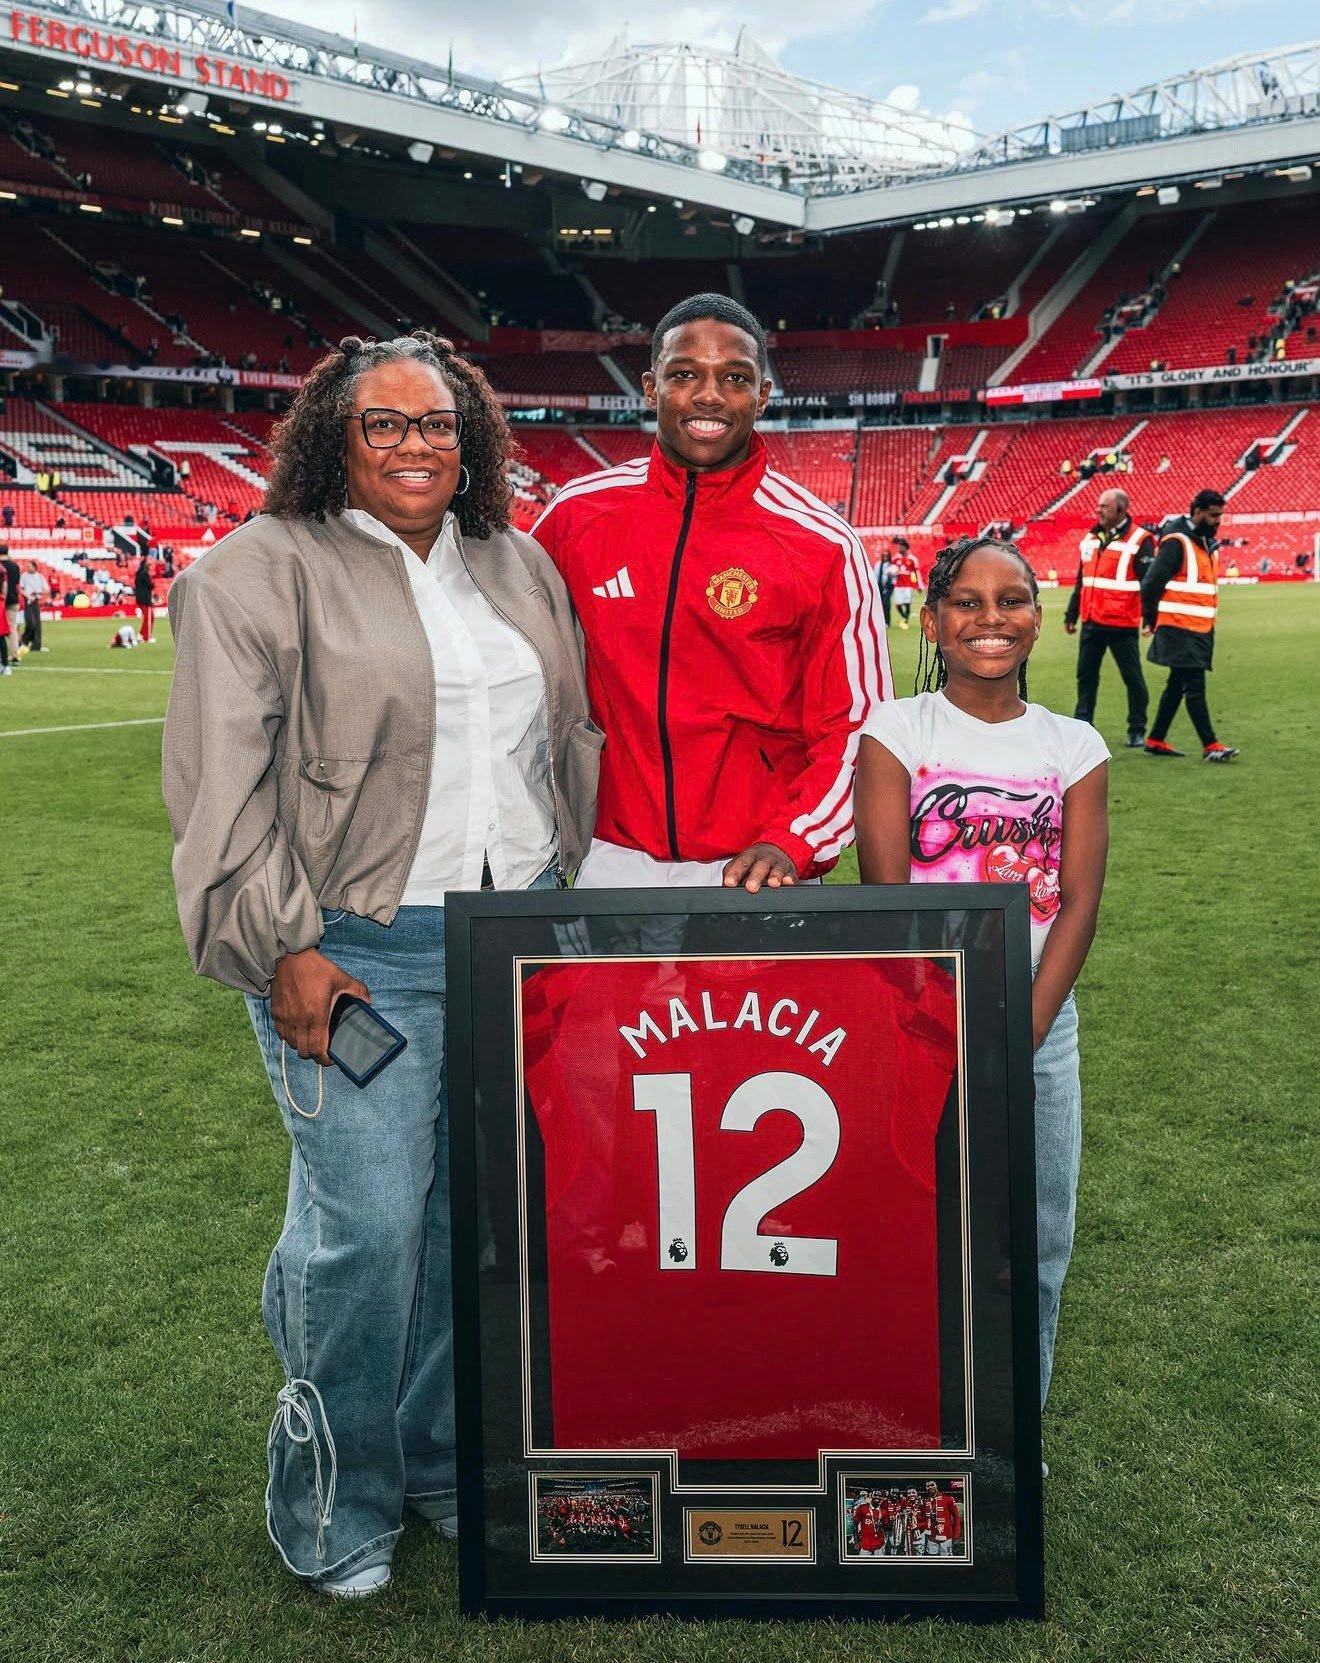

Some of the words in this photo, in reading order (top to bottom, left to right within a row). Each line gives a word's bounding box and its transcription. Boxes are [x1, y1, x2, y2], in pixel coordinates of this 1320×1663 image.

[10, 11, 182, 76] FERGUSON
[195, 54, 289, 100] STAND
[1161, 370, 1204, 384] GLORY
[1213, 367, 1242, 379] AND
[806, 396, 828, 406] ALL
[866, 391, 897, 406] BOBBY
[713, 571, 755, 590] MANCHESTER
[714, 604, 744, 616] UNITED
[618, 991, 848, 1067] MALACIA
[632, 1071, 842, 1277] 12
[781, 1519, 804, 1547] 12
